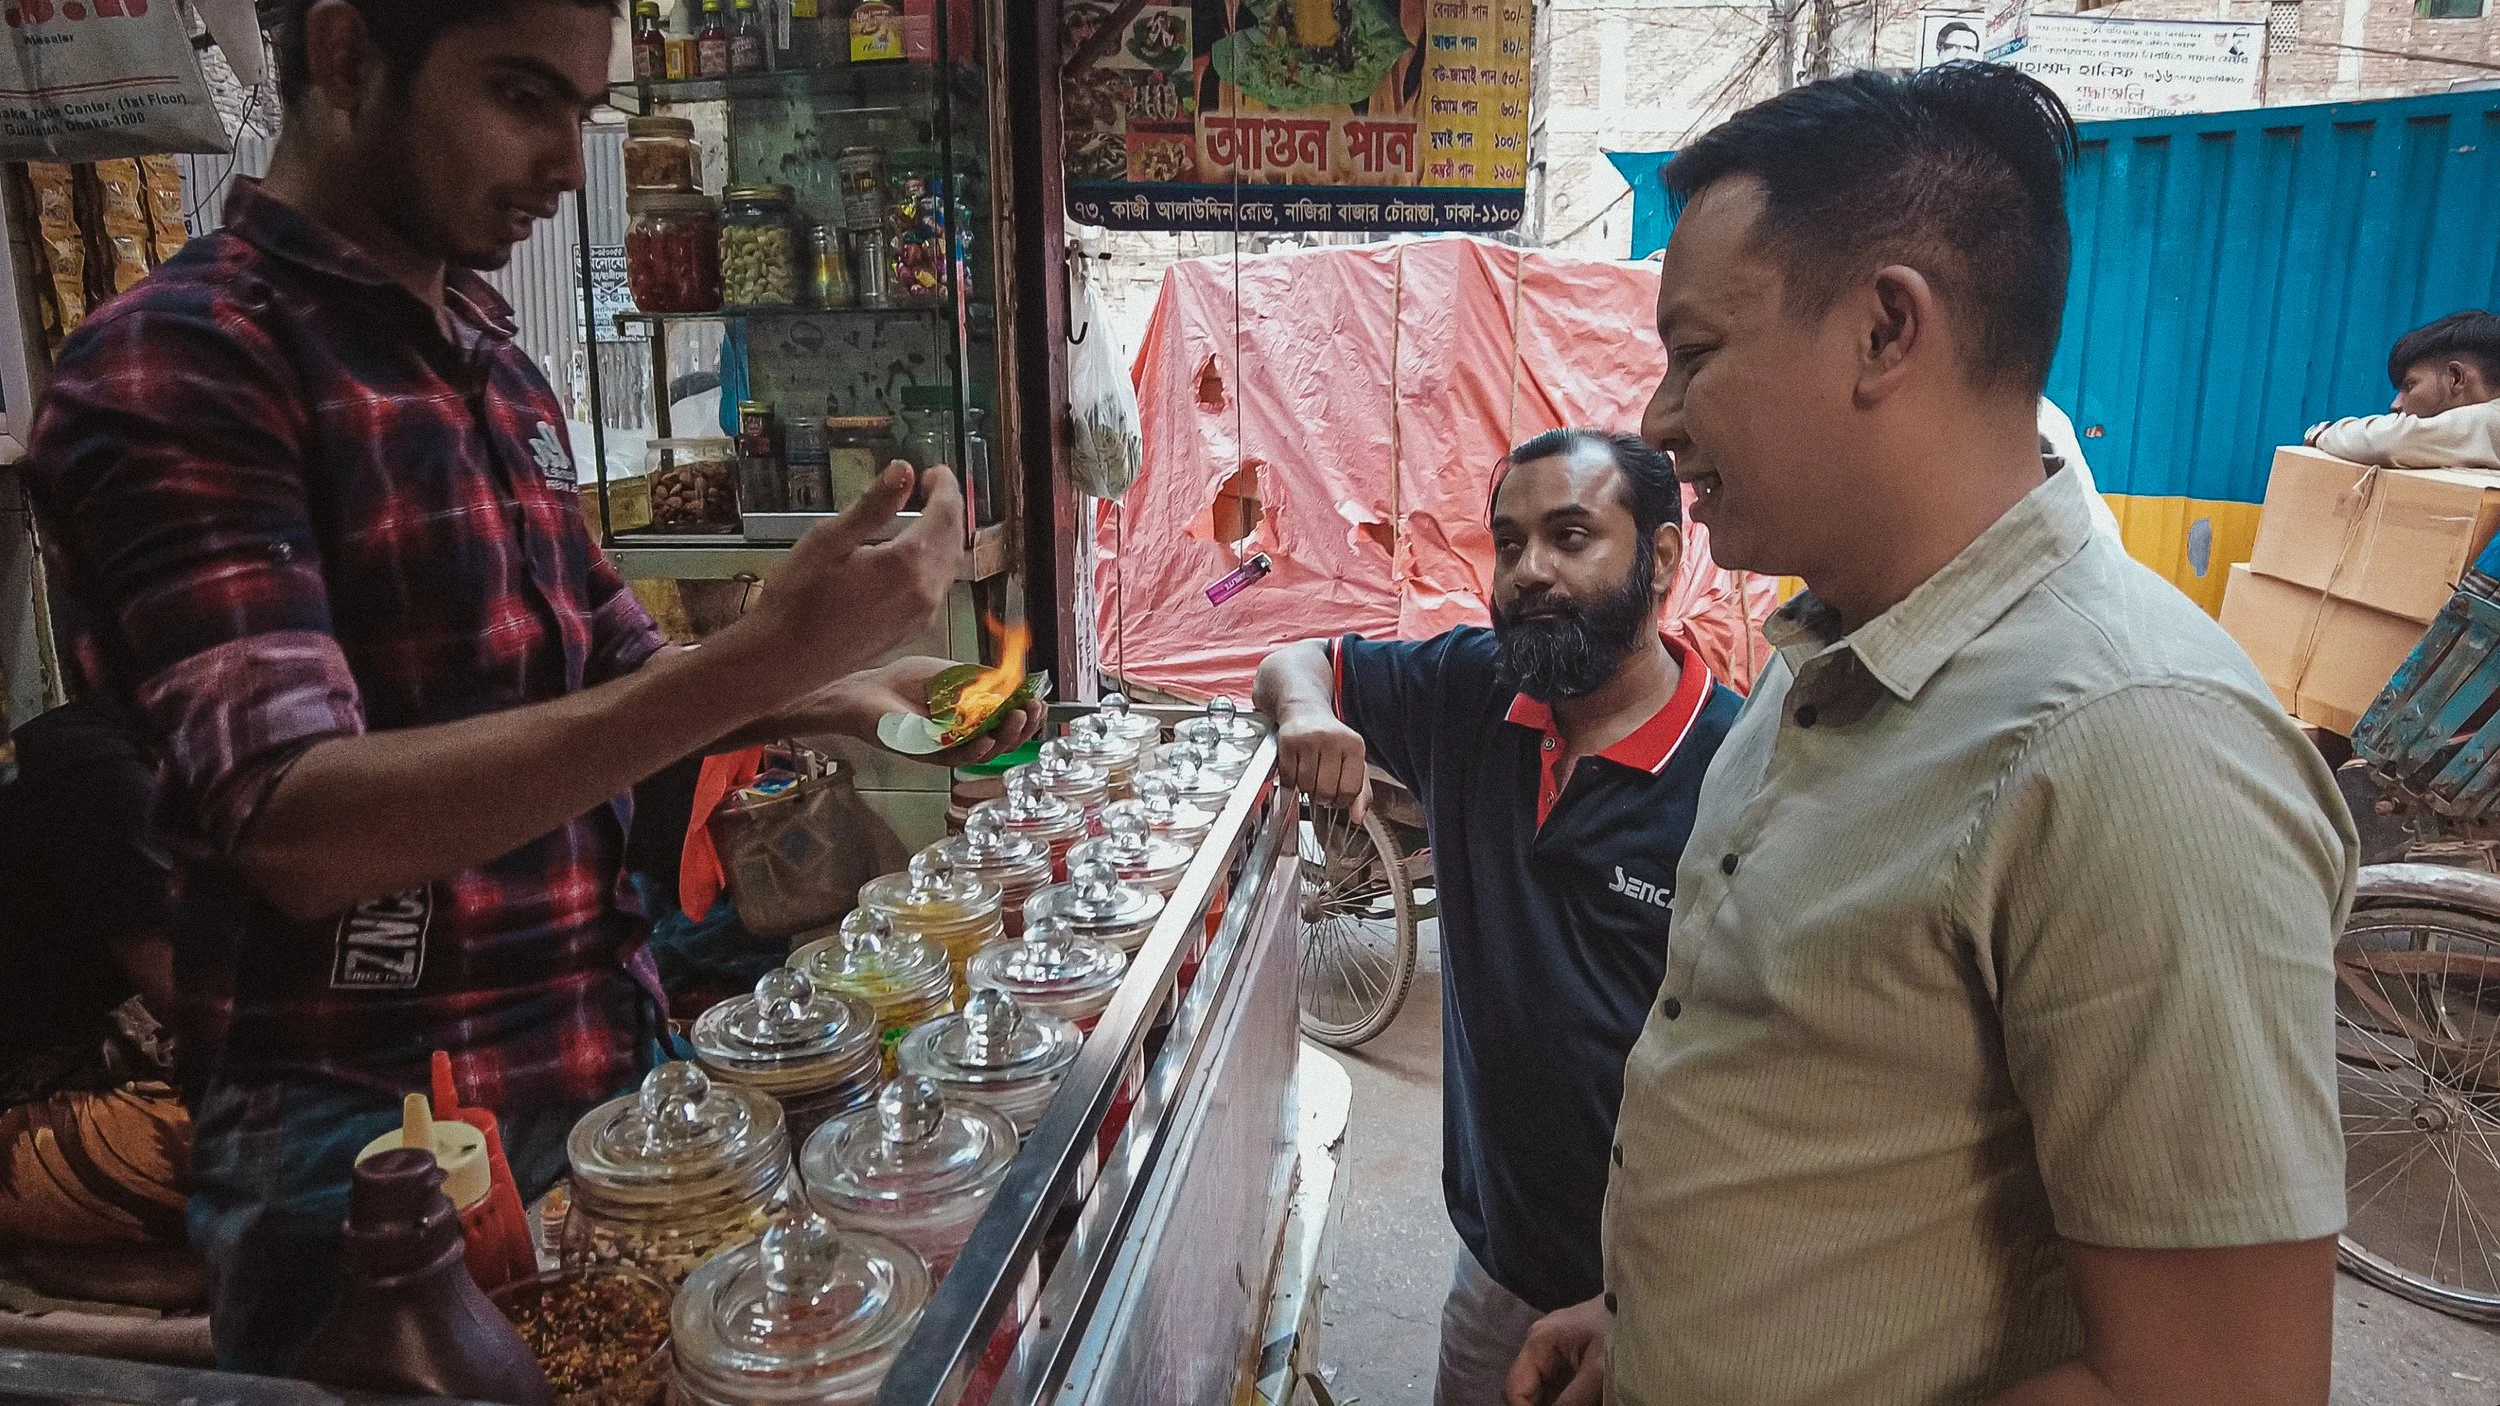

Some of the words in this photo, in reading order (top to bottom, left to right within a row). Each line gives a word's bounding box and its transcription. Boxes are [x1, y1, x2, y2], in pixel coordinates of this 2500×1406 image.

[1472, 5, 1488, 20] পান
[1432, 35, 1457, 51] আগুন
[1461, 37, 1477, 52] পান
[1481, 69, 1497, 84] পান
[0, 107, 27, 120] aka
[148, 93, 187, 107] Floor)
[1461, 101, 1478, 116] পান
[1204, 116, 1331, 172] আগুন
[1343, 120, 1418, 173] পান
[1457, 132, 1473, 148] পান
[1458, 163, 1474, 179] পান
[1109, 194, 1150, 221] কাজী
[1155, 196, 1234, 222] আলাউদ্দিন
[1239, 201, 1279, 225] রোড,
[1284, 197, 1332, 222] নাজিরা
[1336, 202, 1378, 222] বাজার
[1444, 202, 1520, 224] ঢাকা-১১০০
